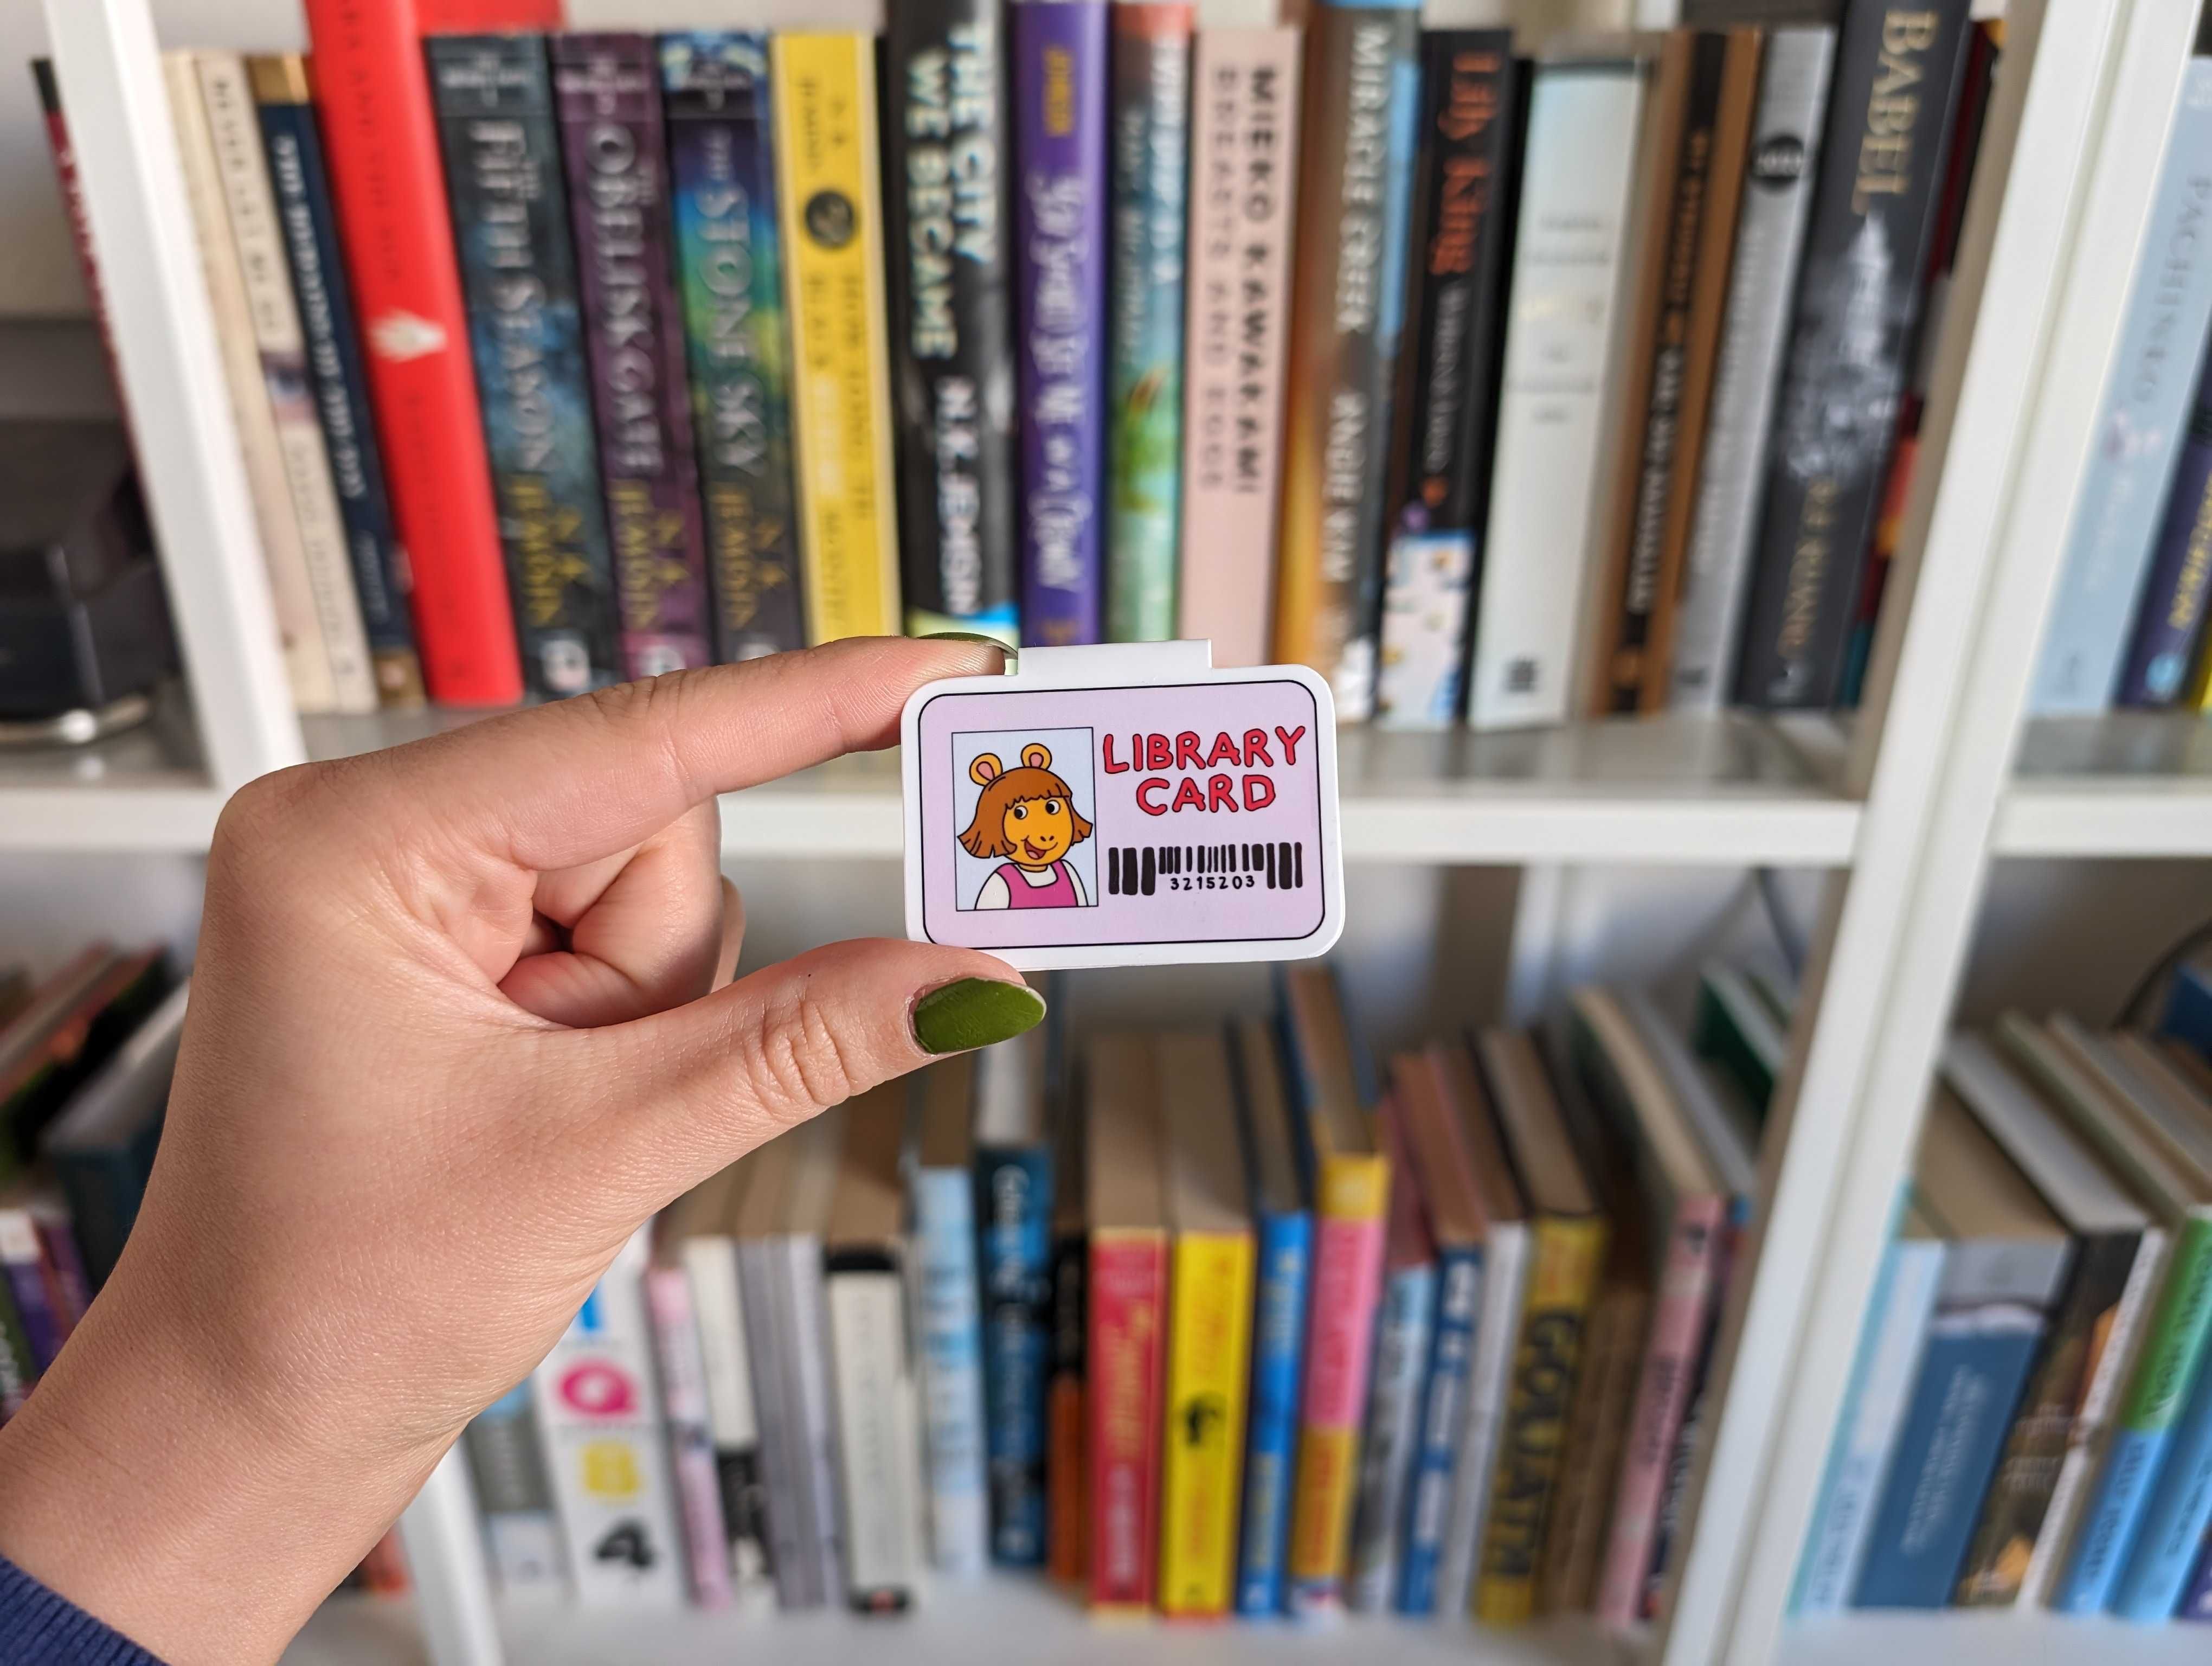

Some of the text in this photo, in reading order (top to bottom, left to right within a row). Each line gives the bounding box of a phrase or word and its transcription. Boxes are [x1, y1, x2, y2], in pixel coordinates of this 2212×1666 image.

[905, 48, 957, 359] WE BECAME
[946, 23, 998, 265] THE CITY
[1334, 23, 1393, 334] MIRACLE CREEK
[1426, 153, 1492, 275] King
[1850, 10, 1938, 216] BABEL
[586, 123, 652, 346] OBELISK
[694, 183, 759, 362] STONE
[1234, 66, 1279, 494] MIEKO KAWAKAMI
[2131, 175, 2212, 403] PACHINKO
[492, 274, 561, 473] SEASON
[606, 346, 664, 475] GATE
[713, 379, 770, 477] SKY
[1103, 725, 1306, 774] LIBRARY
[1136, 774, 1276, 816] CARD
[1169, 875, 1256, 891] 3215203
[1499, 1311, 1587, 1579] GOLIATH
